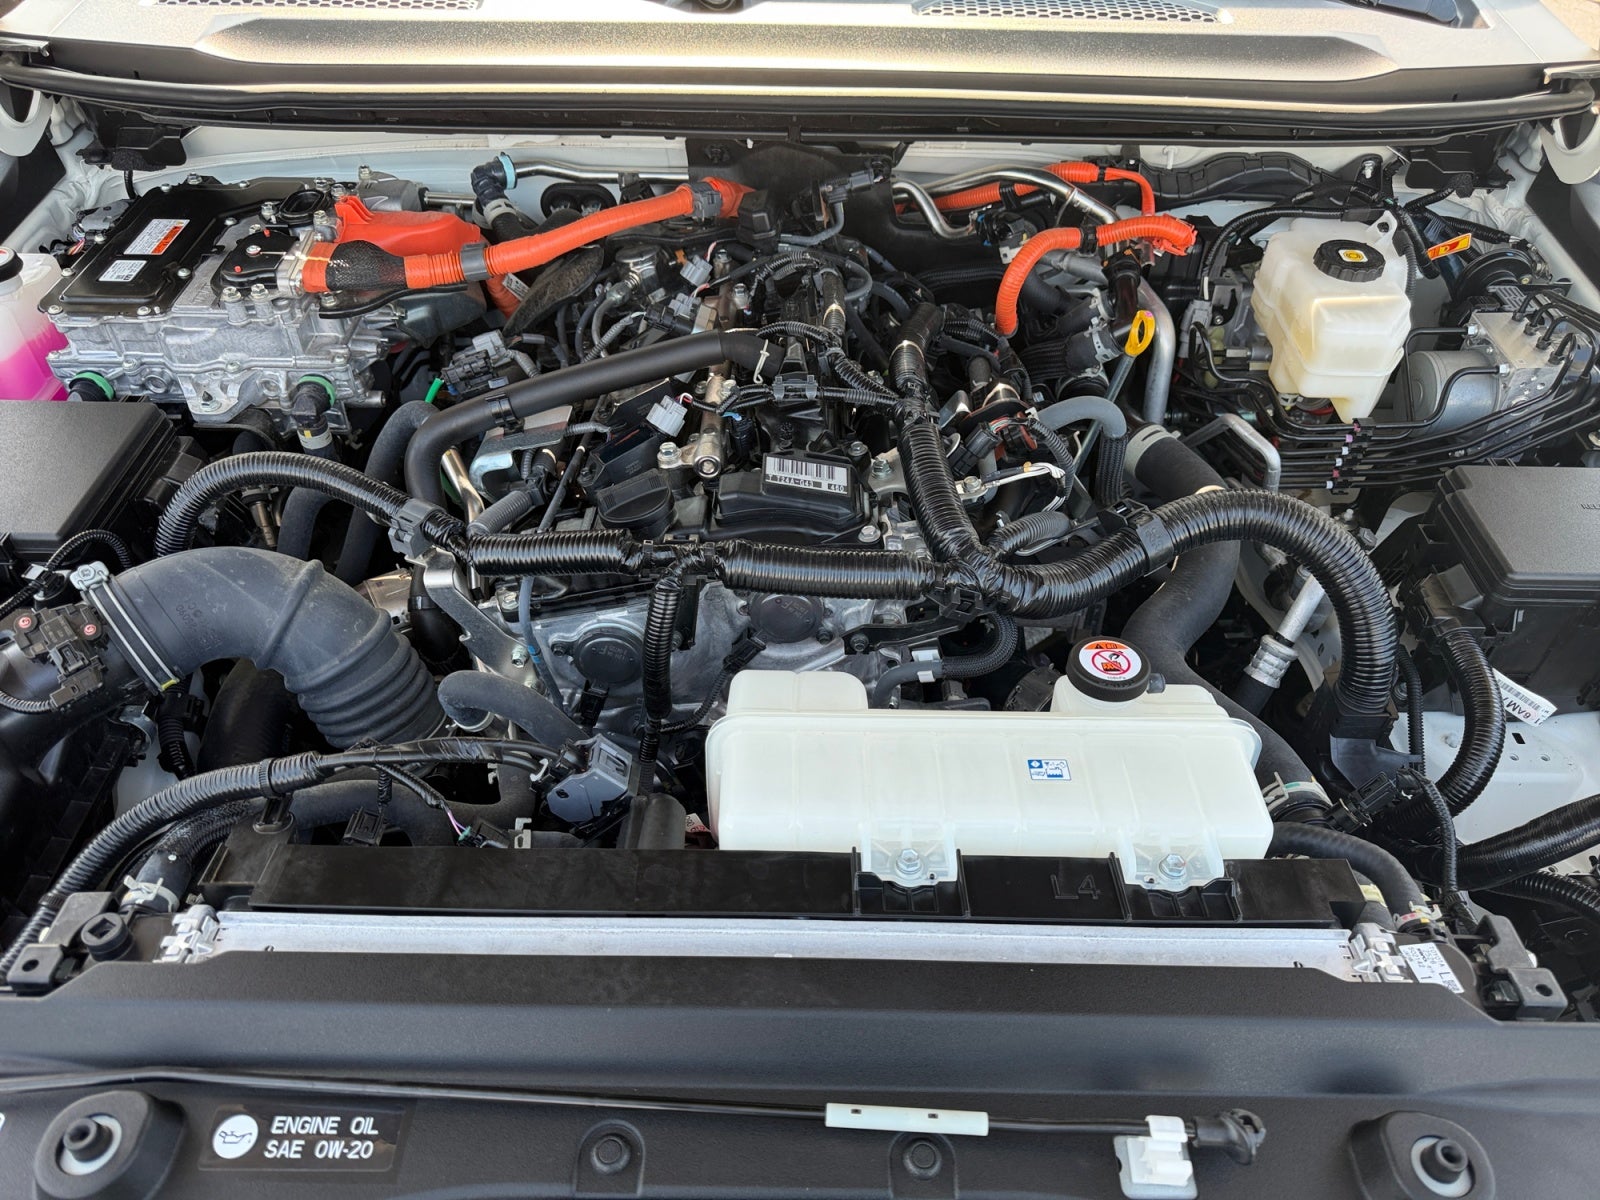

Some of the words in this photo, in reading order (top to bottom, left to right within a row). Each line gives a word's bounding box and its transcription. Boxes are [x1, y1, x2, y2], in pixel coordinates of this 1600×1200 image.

[1050, 874, 1101, 900] L4
[271, 1115, 341, 1135] ENGINE
[350, 1116, 379, 1135] OIL
[264, 1139, 305, 1159] SAE
[315, 1140, 374, 1159] 0W-20
